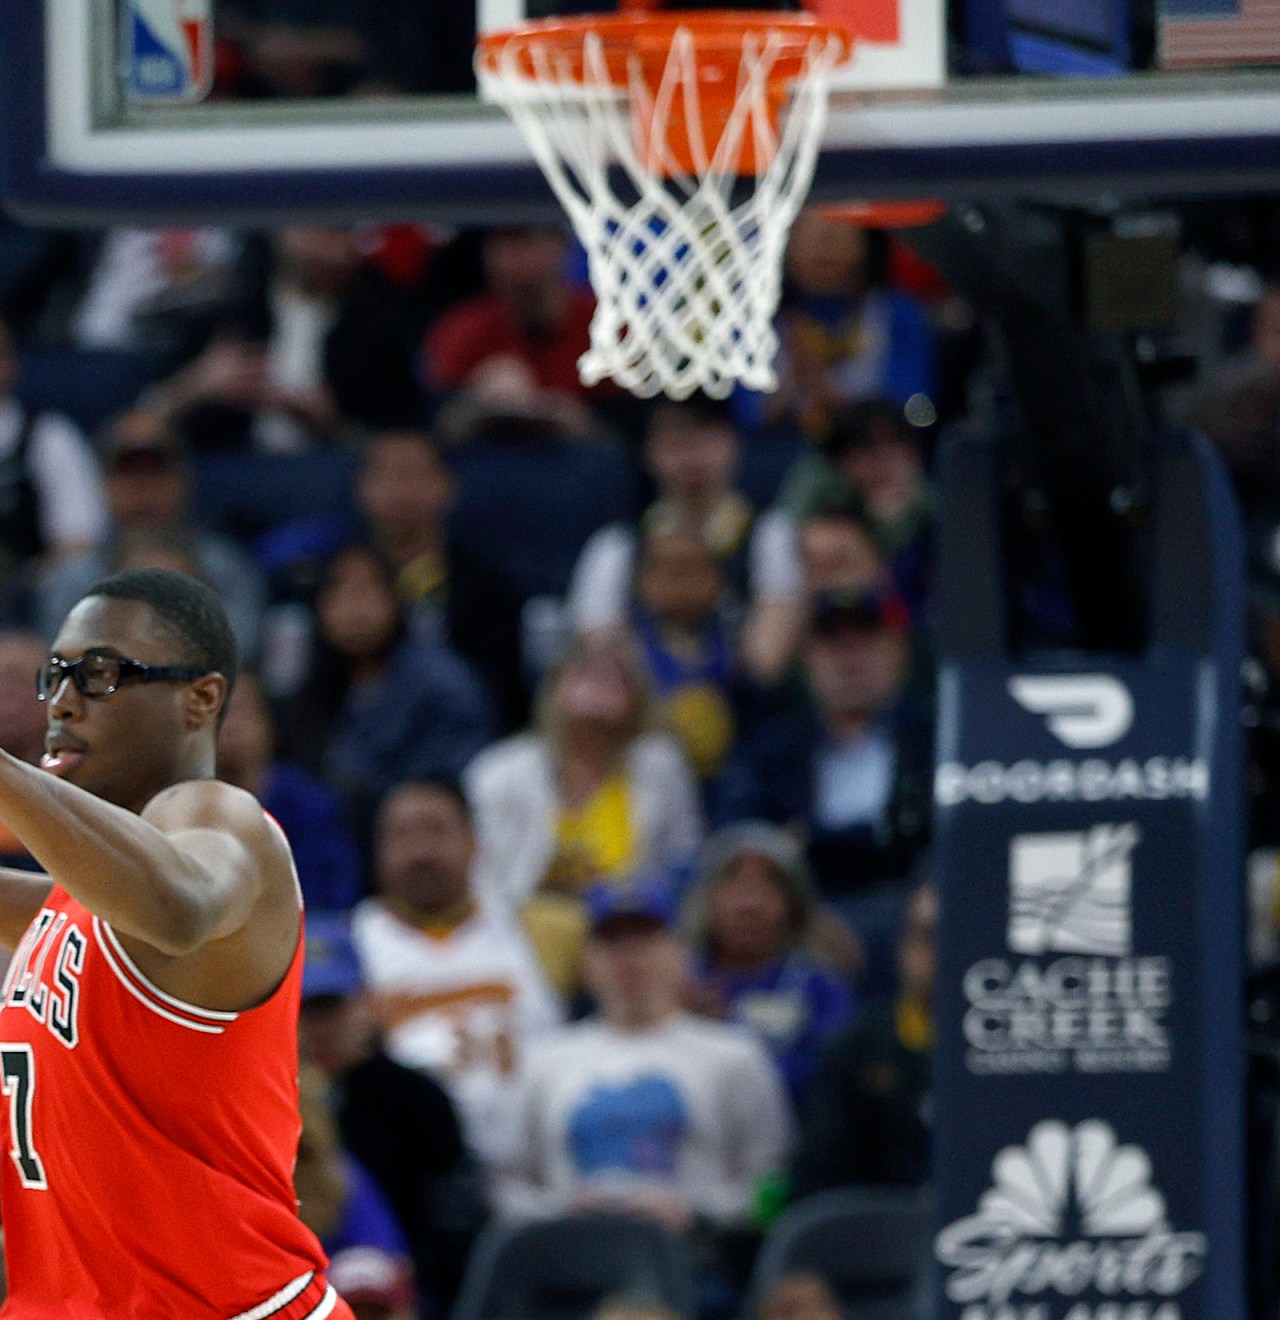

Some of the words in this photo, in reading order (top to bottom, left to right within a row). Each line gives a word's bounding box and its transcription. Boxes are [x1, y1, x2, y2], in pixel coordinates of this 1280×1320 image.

[934, 757, 1209, 805] DOORDASH
[963, 956, 1172, 1009] CACHE
[963, 1006, 1172, 1050] CREEK
[936, 1220, 1208, 1303] Sports
